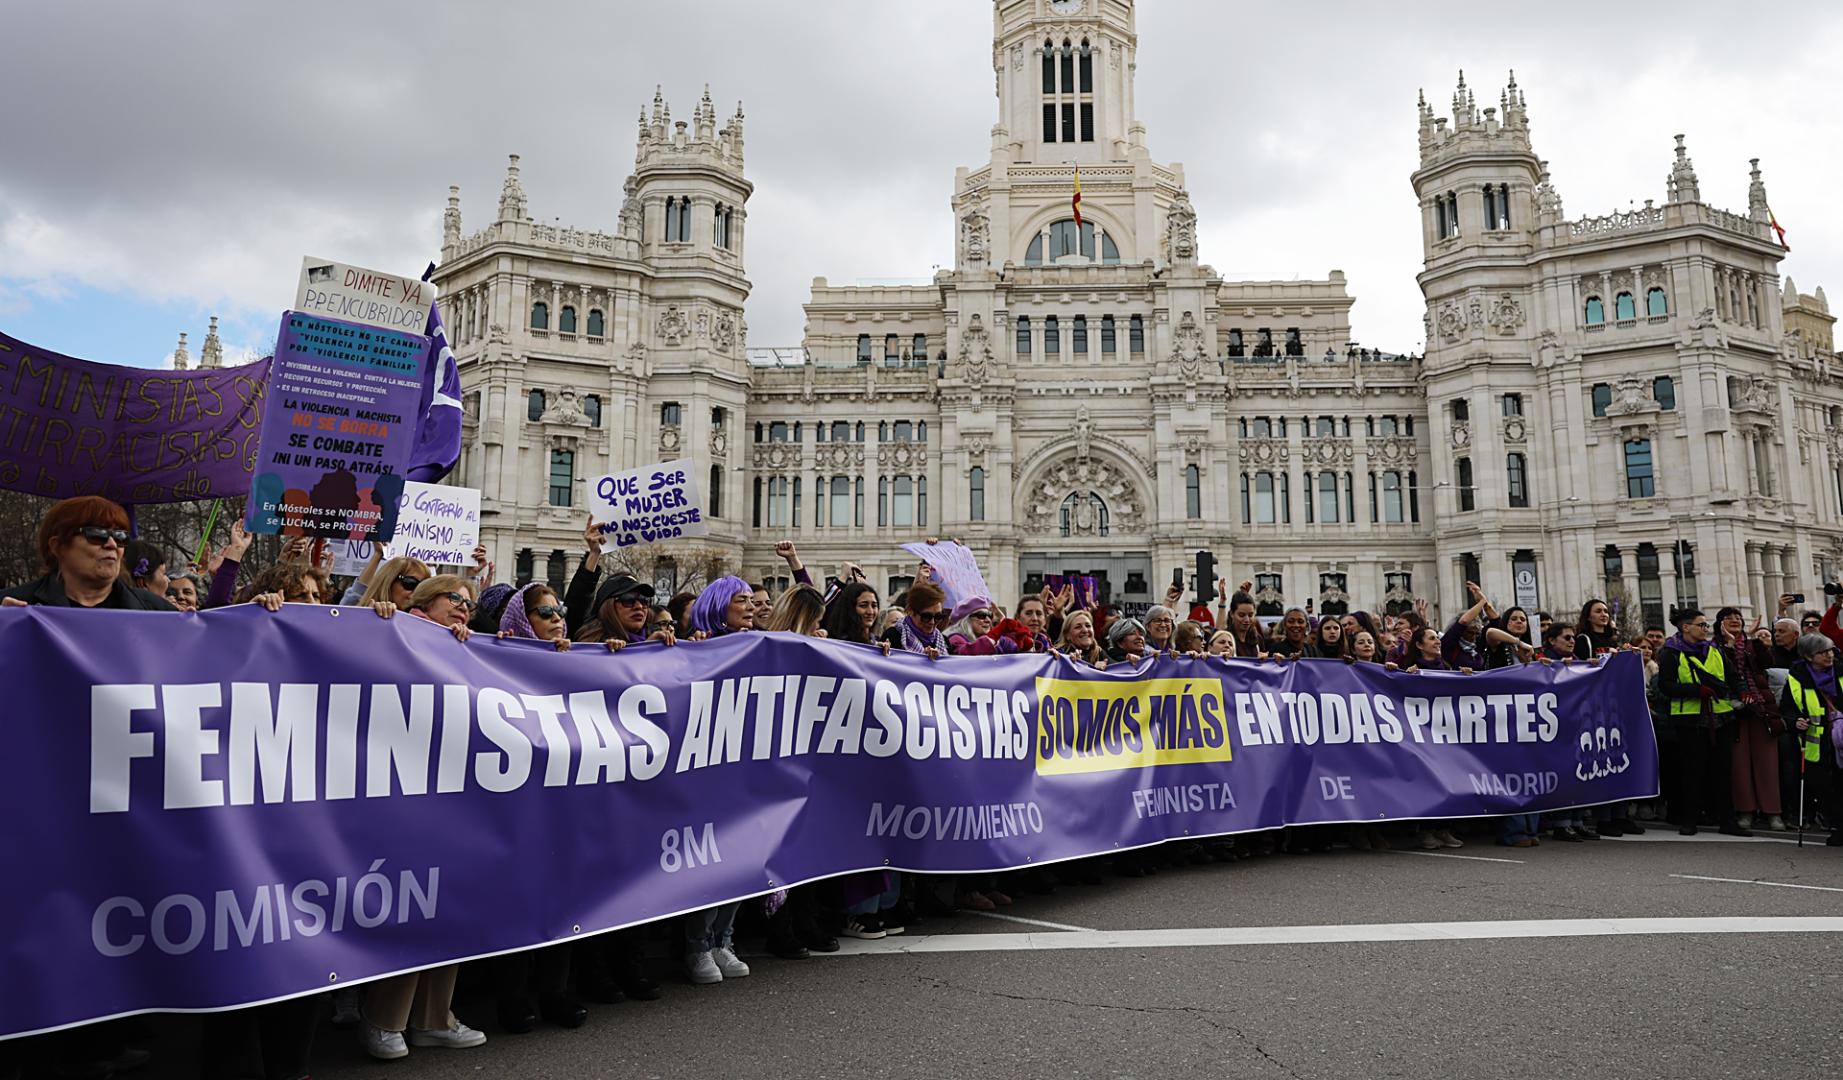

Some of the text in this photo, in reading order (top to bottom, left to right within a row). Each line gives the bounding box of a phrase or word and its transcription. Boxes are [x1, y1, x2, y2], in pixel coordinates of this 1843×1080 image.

[344, 269, 396, 298] DIMITE
[290, 319, 422, 350] EN MÓSTOLES NO SE CAMBIA
[289, 343, 308, 353] POR
[357, 343, 368, 352] DE
[0, 343, 222, 423] MINISTAS
[312, 377, 343, 388] RECURSOS
[322, 367, 331, 375] LA
[332, 368, 361, 379] VIOLENCIA
[364, 374, 388, 384] CONTRA
[281, 384, 290, 392] ES
[291, 385, 300, 393] UN
[301, 387, 335, 398] RETROCESO
[283, 398, 402, 424] LA VIOLENCIA MACHISTA
[292, 412, 389, 438] NO SE BORRA
[288, 433, 384, 457] SE COMBATE
[294, 454, 311, 467] UN
[315, 457, 345, 470] PASO
[349, 460, 394, 476] ATRÁS!
[597, 471, 686, 506] QUE SER
[263, 501, 384, 521] En Móstoles se NOMBRA,
[625, 487, 687, 515] MUJER
[266, 517, 378, 533] se LUCHA, se PROTEGE.
[465, 510, 477, 522] AL
[347, 540, 371, 559] NO
[90, 675, 1559, 814] FEMINISTAS ANTIFASCISTAS SOMOS MÁS EN TODAS PARTES
[91, 771, 1559, 957] COMISIÓN 8M MOVIMIENTO FEMINISTA DE MADRID
